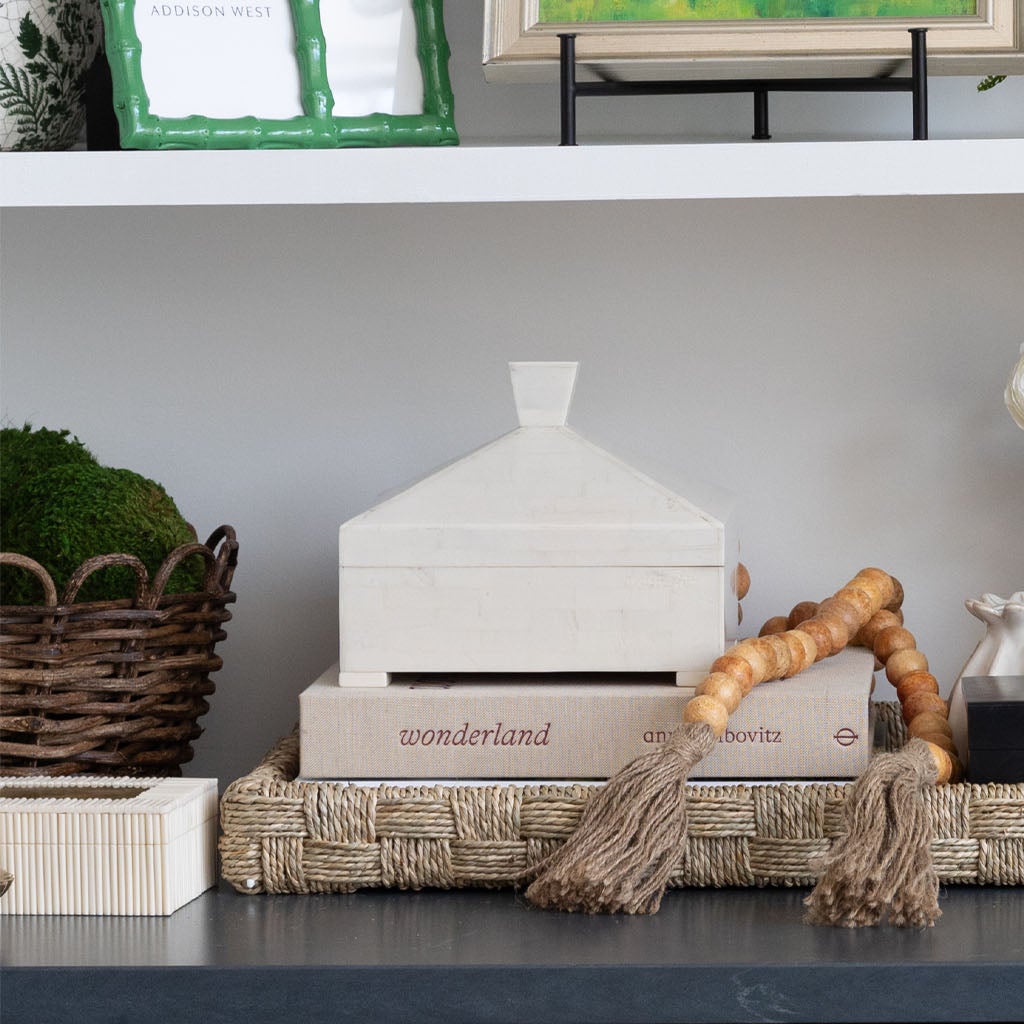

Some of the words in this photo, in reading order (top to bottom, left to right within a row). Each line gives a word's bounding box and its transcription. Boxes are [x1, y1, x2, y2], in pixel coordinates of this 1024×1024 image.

[151, 4, 225, 17] ADDISON
[231, 6, 272, 18] WEST
[399, 722, 551, 746] wonderland
